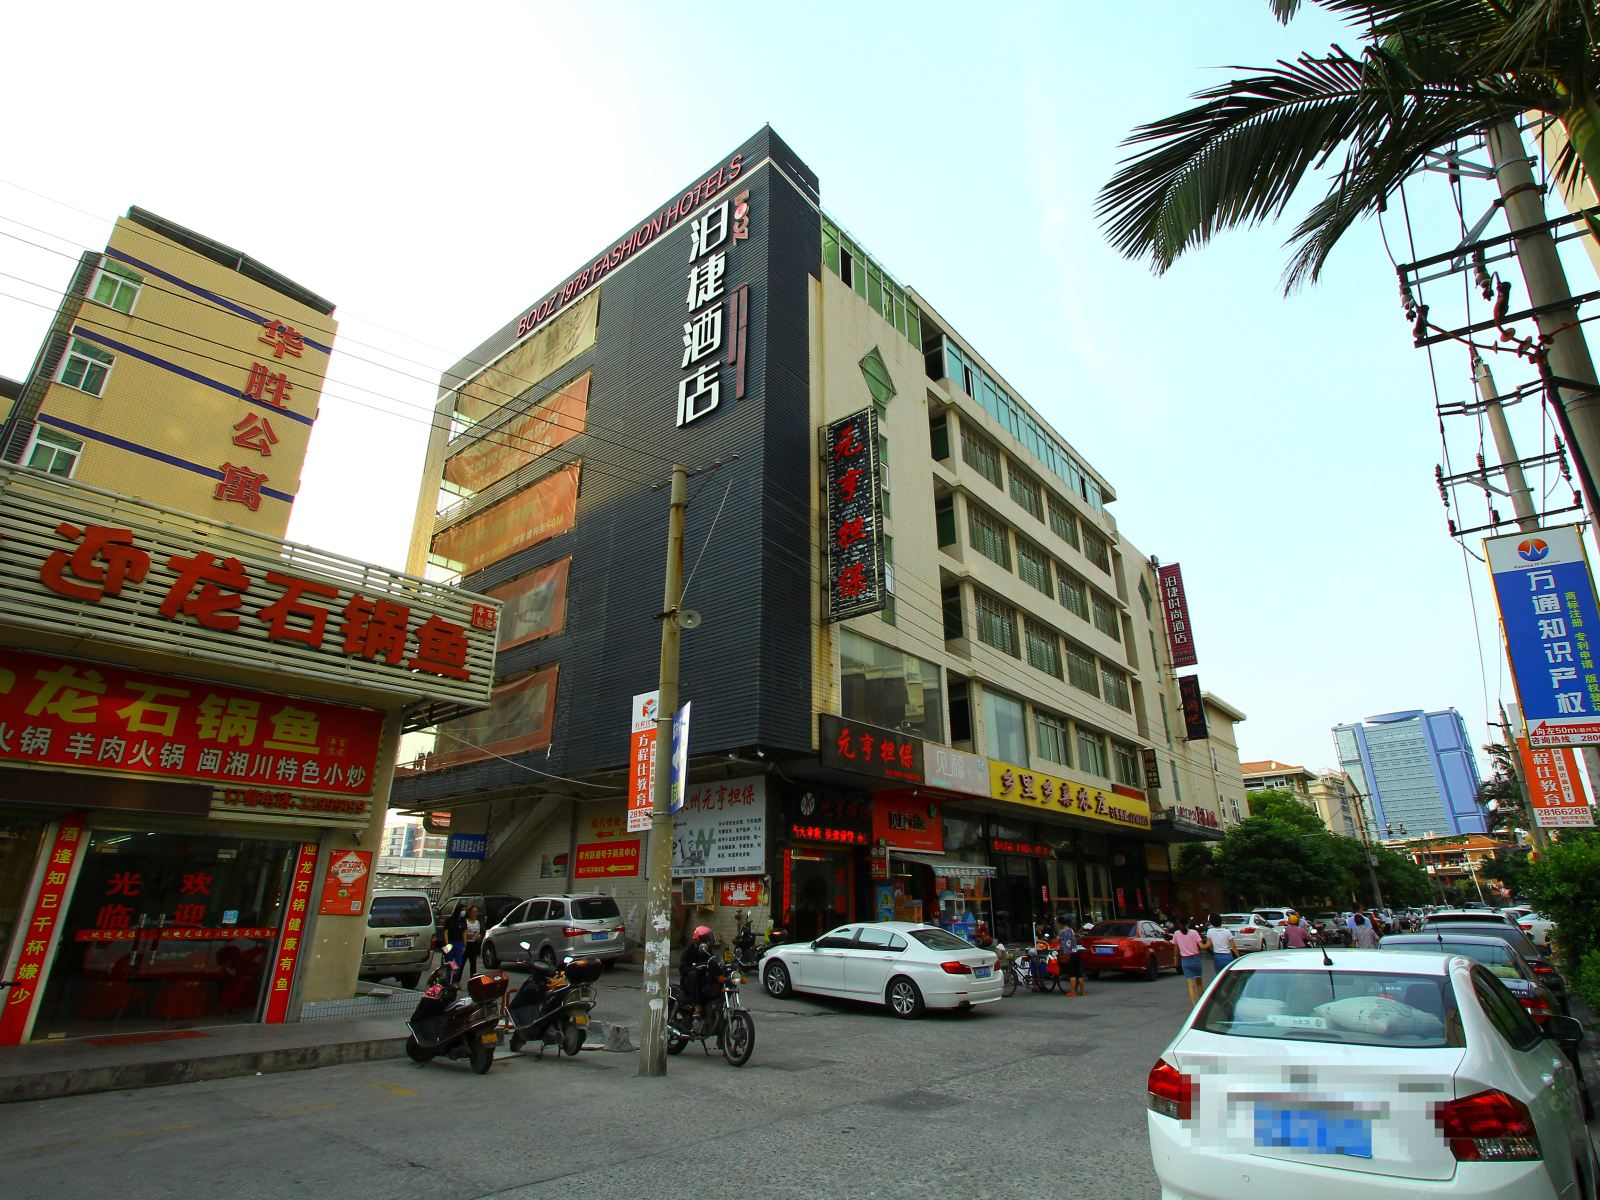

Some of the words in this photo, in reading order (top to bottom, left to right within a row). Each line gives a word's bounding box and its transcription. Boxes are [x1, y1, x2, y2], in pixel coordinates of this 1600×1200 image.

[517, 292, 558, 338] BOOZ
[560, 269, 590, 305] 1978
[590, 212, 664, 285] FASHION
[676, 199, 729, 427] 泊捷酒店
[214, 319, 305, 511] 华胜公寓
[833, 424, 868, 600] 元亨担保
[41, 522, 471, 681] 迎龙石锅鱼
[1164, 576, 1188, 644] 泊捷时尚酒店
[1564, 591, 1584, 627] 商标注册
[1526, 569, 1587, 714] 万通知识产权
[1573, 632, 1594, 669] 专利申请
[65, 731, 187, 770] 羊肉火锅
[197, 747, 367, 788] 闽湘川特色小炒
[636, 733, 649, 807] 方程仕教育
[837, 728, 915, 768] 元亨担保
[1531, 747, 1562, 806] 程仕教育
[682, 784, 755, 813] 州元亨担保
[1000, 768, 1110, 816] 乡里乡亲农庄
[1537, 808, 1588, 816] 28166288
[275, 843, 317, 991] 迎龙石锅健康有鱼
